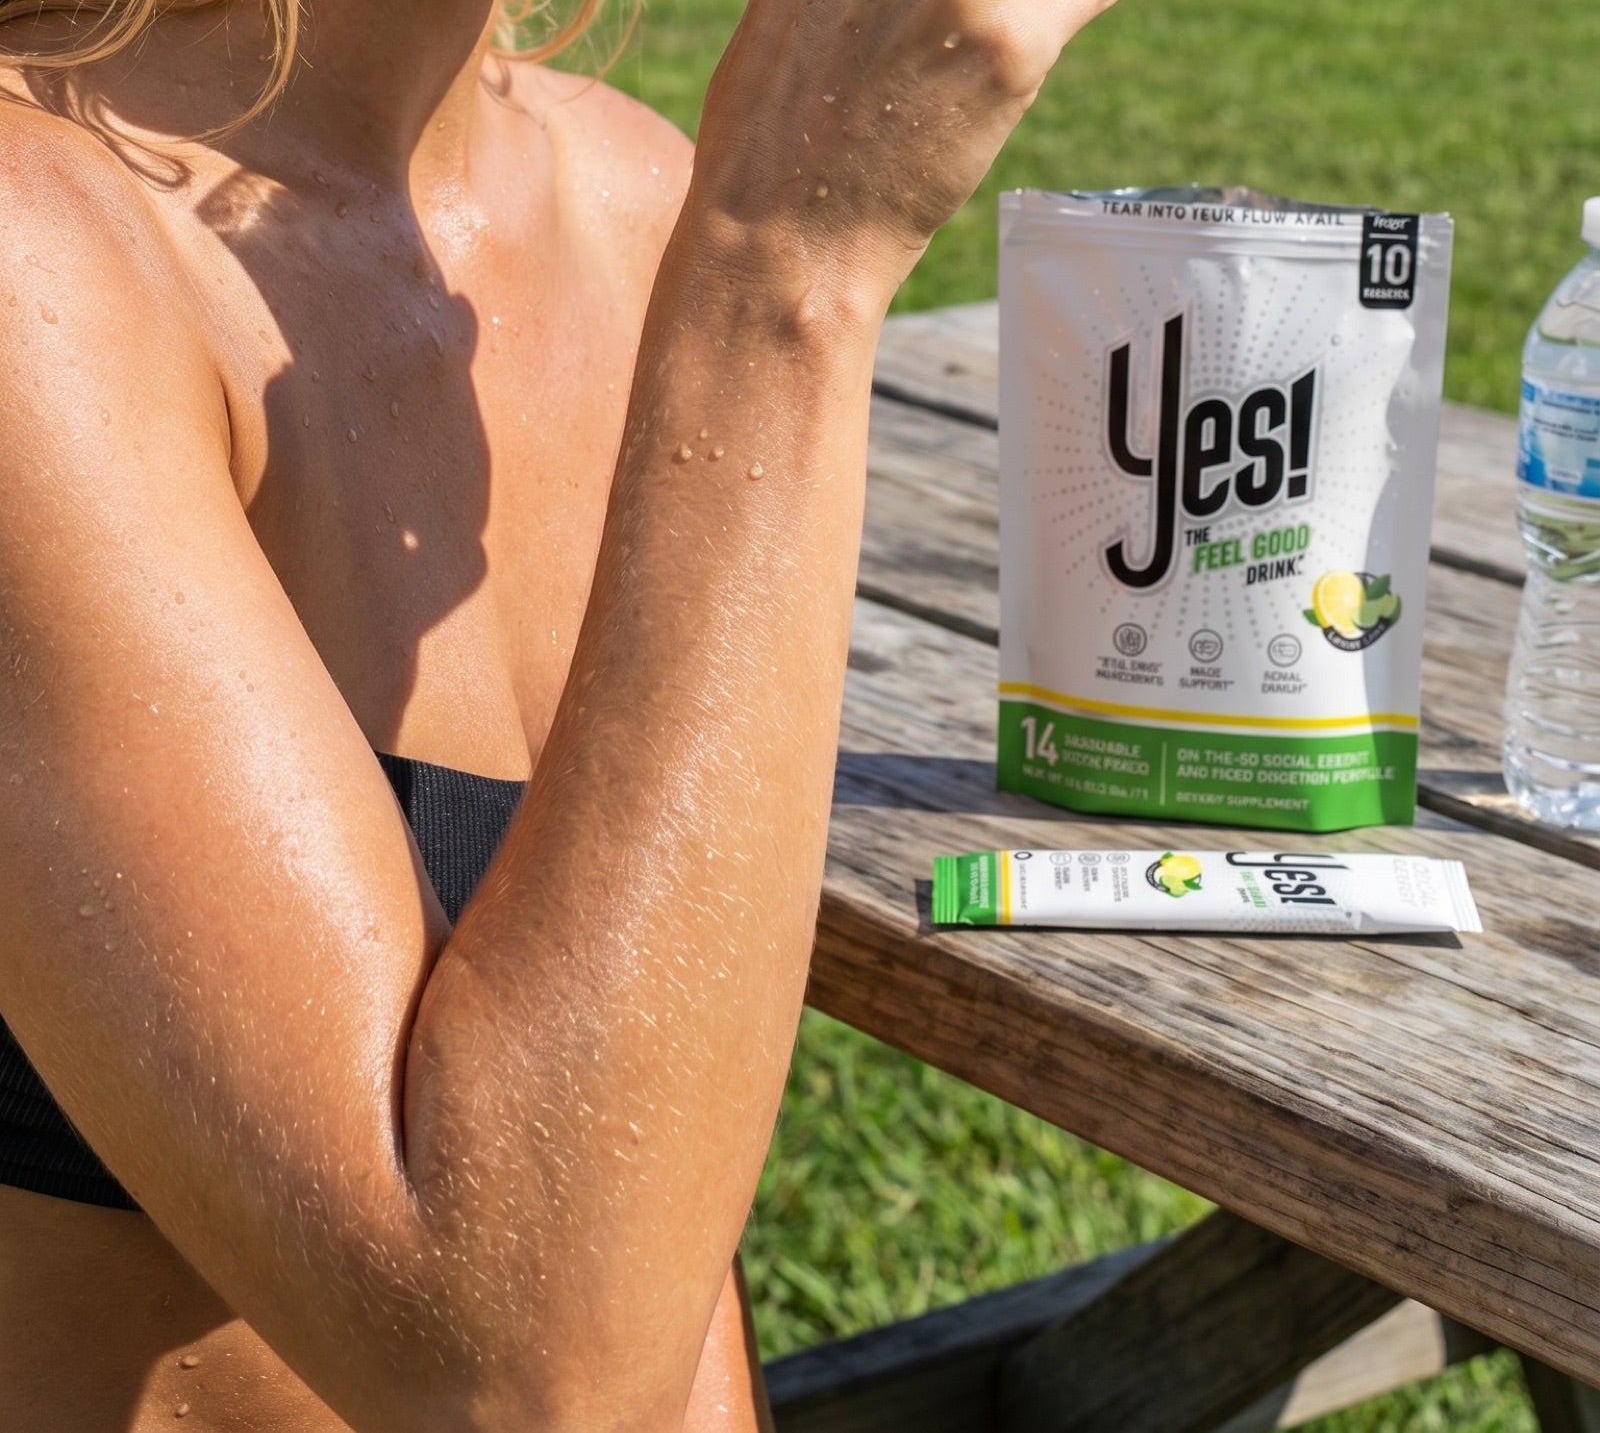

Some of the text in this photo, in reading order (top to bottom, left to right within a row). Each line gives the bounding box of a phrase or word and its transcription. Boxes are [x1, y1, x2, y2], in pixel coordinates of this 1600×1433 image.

[1102, 201, 1142, 216] TEAR
[1148, 204, 1186, 220] INTO
[1366, 243, 1411, 285] 10
[1185, 527, 1210, 546] THE
[1193, 523, 1310, 573] FEEL GOOD
[1021, 716, 1058, 766] 14
[1176, 747, 1200, 762] ON
[1262, 752, 1313, 769] SOCIAL
[1176, 764, 1208, 780] AND
[1226, 793, 1310, 811] SUPPLEMENT
